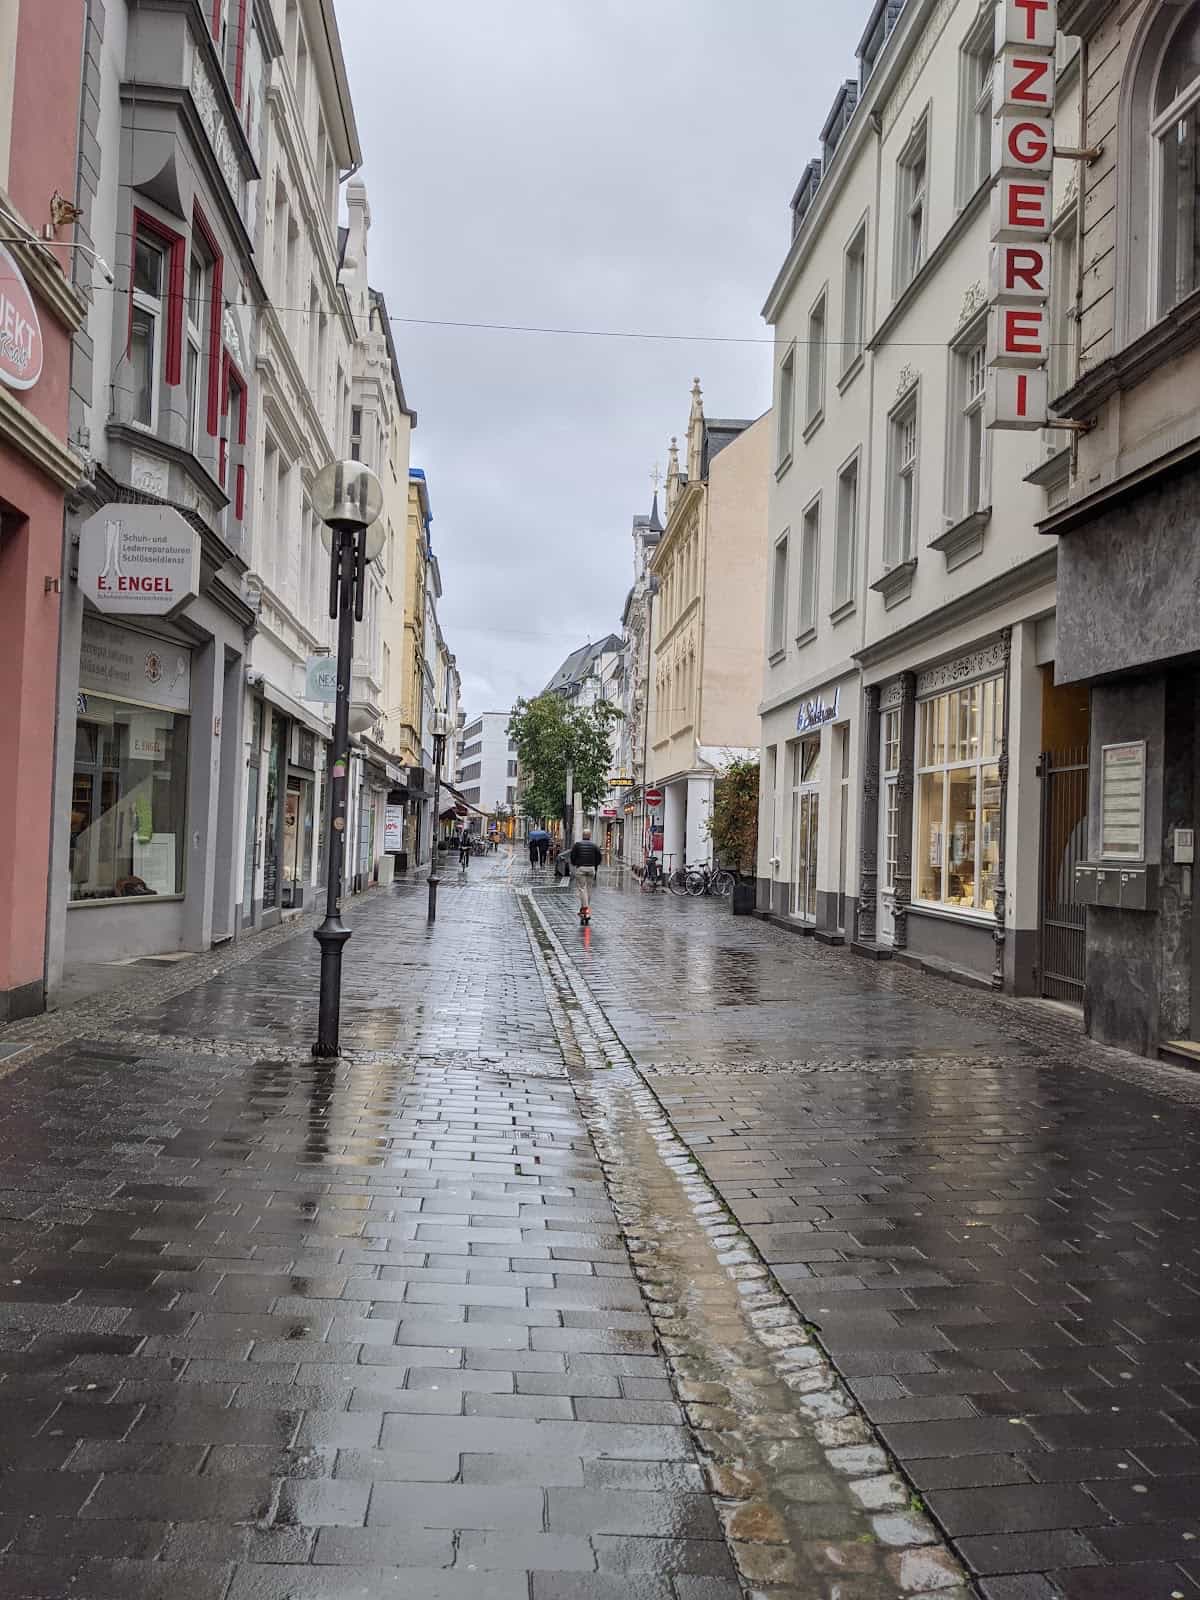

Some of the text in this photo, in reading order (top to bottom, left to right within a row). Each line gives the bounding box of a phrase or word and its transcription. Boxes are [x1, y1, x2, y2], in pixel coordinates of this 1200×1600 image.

[152, 535, 168, 543] und
[122, 544, 191, 554] Lederreparaturen
[122, 554, 184, 564] Schlüsseldienst
[97, 576, 173, 592] E. ENGEL
